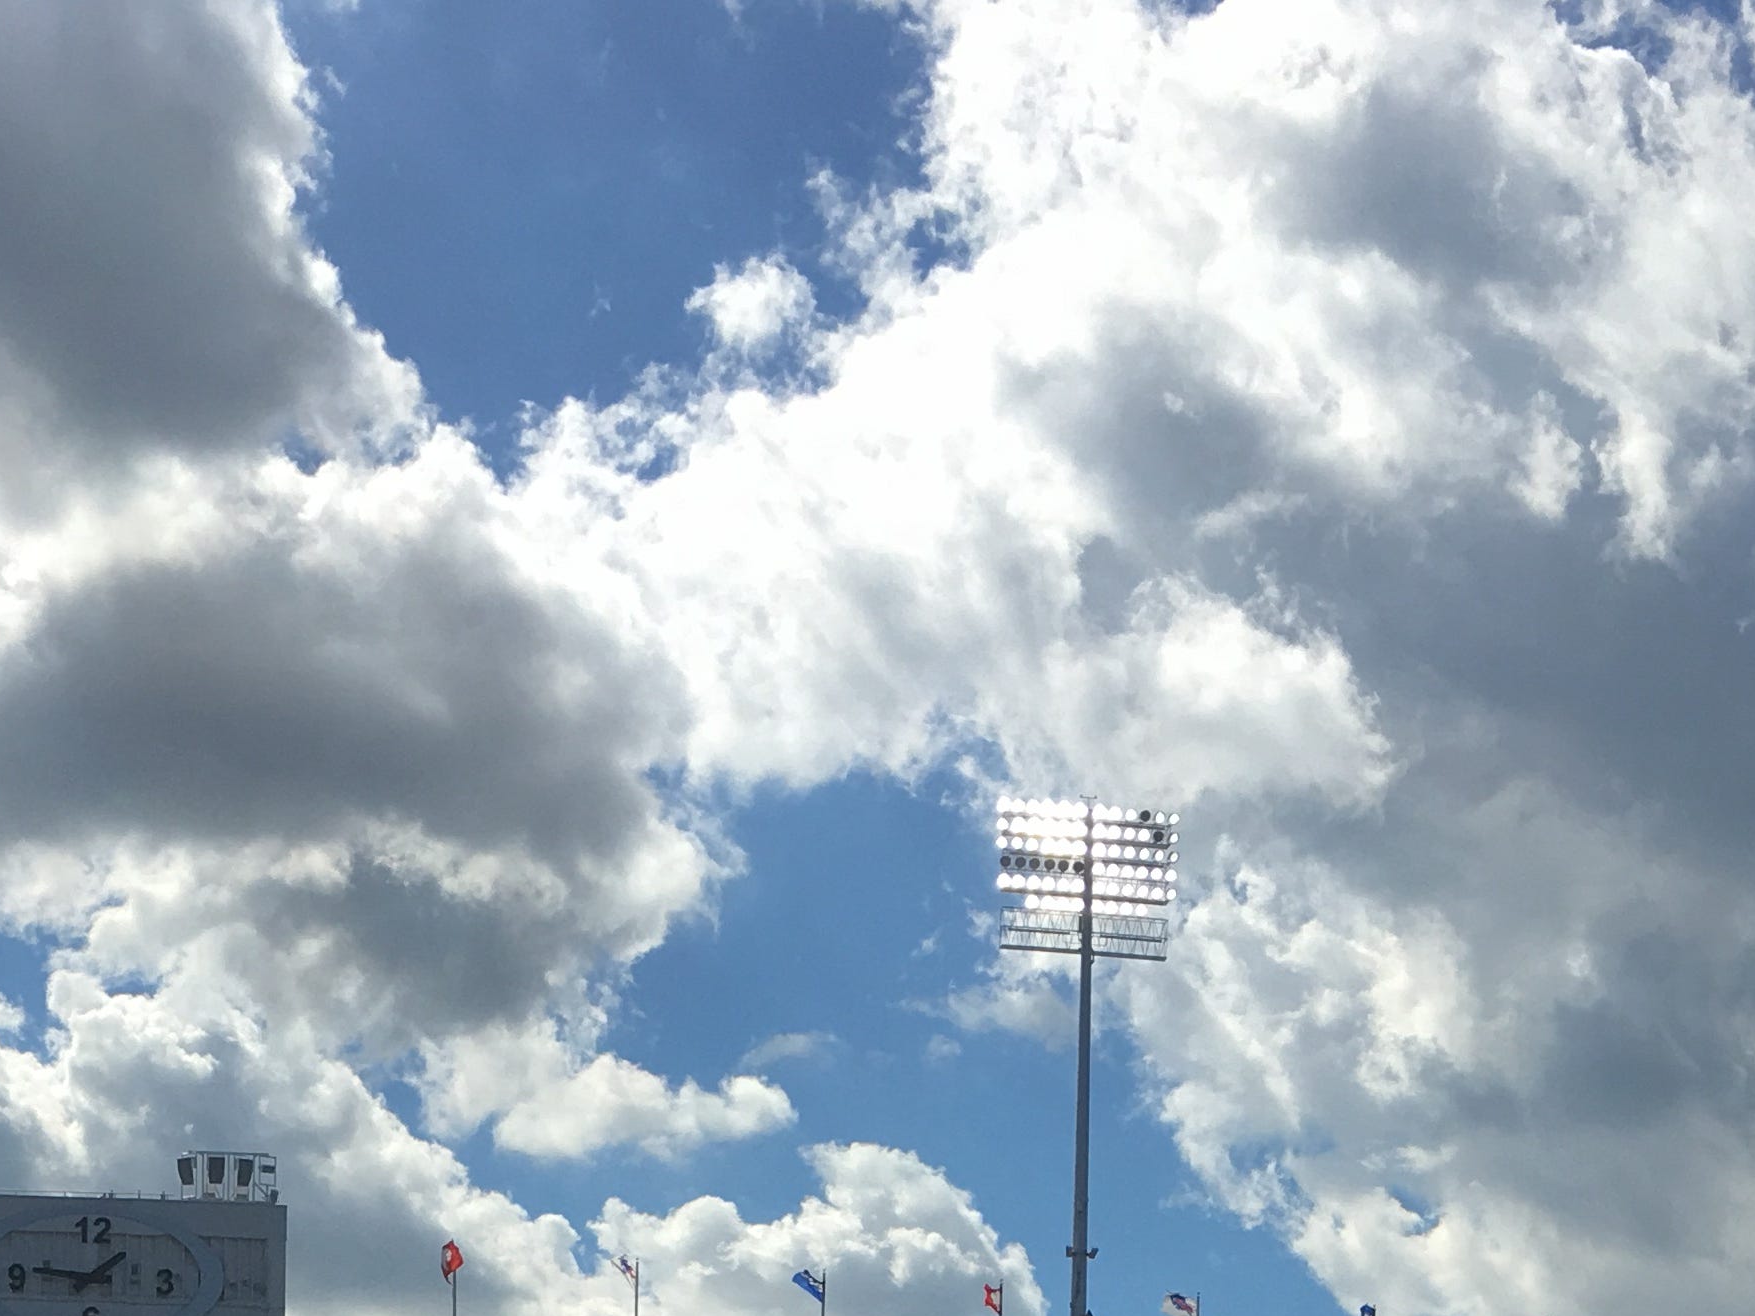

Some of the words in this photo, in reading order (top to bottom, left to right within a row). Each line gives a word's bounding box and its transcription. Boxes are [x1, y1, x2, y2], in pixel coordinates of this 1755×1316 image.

[75, 1216, 112, 1244] 12
[8, 1263, 26, 1292] 9
[156, 1268, 175, 1296] 3
